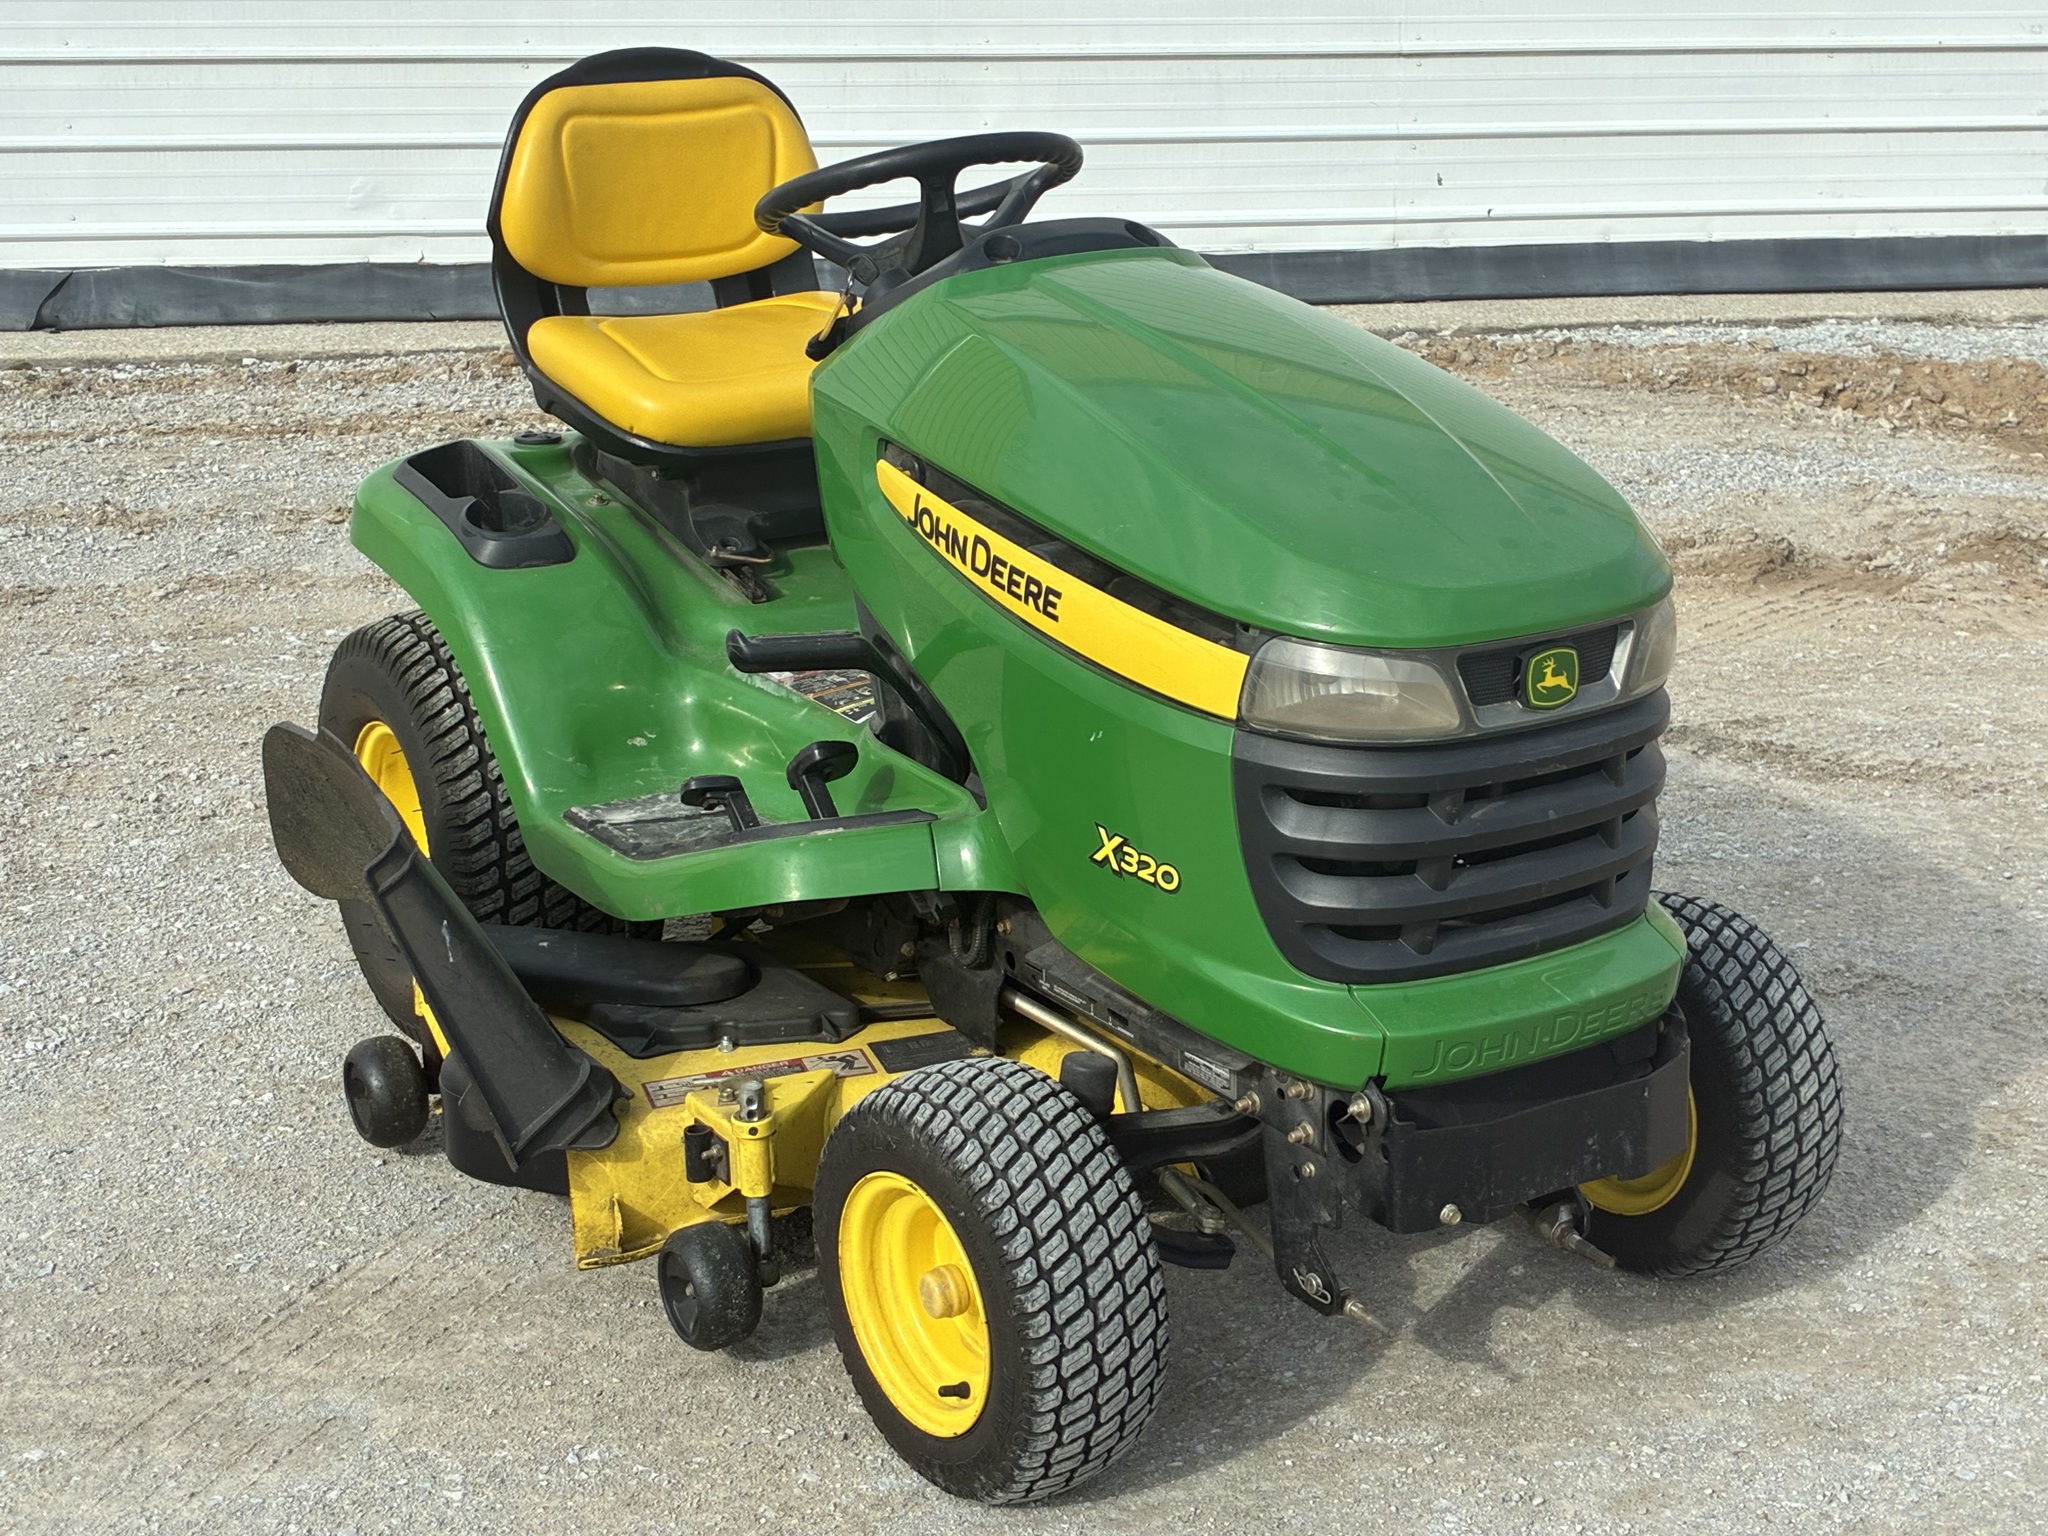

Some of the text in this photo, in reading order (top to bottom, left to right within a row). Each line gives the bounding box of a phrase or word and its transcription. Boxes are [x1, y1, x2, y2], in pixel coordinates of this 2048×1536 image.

[907, 492, 1063, 623] JOHN DEERE
[1089, 822, 1181, 893] X320
